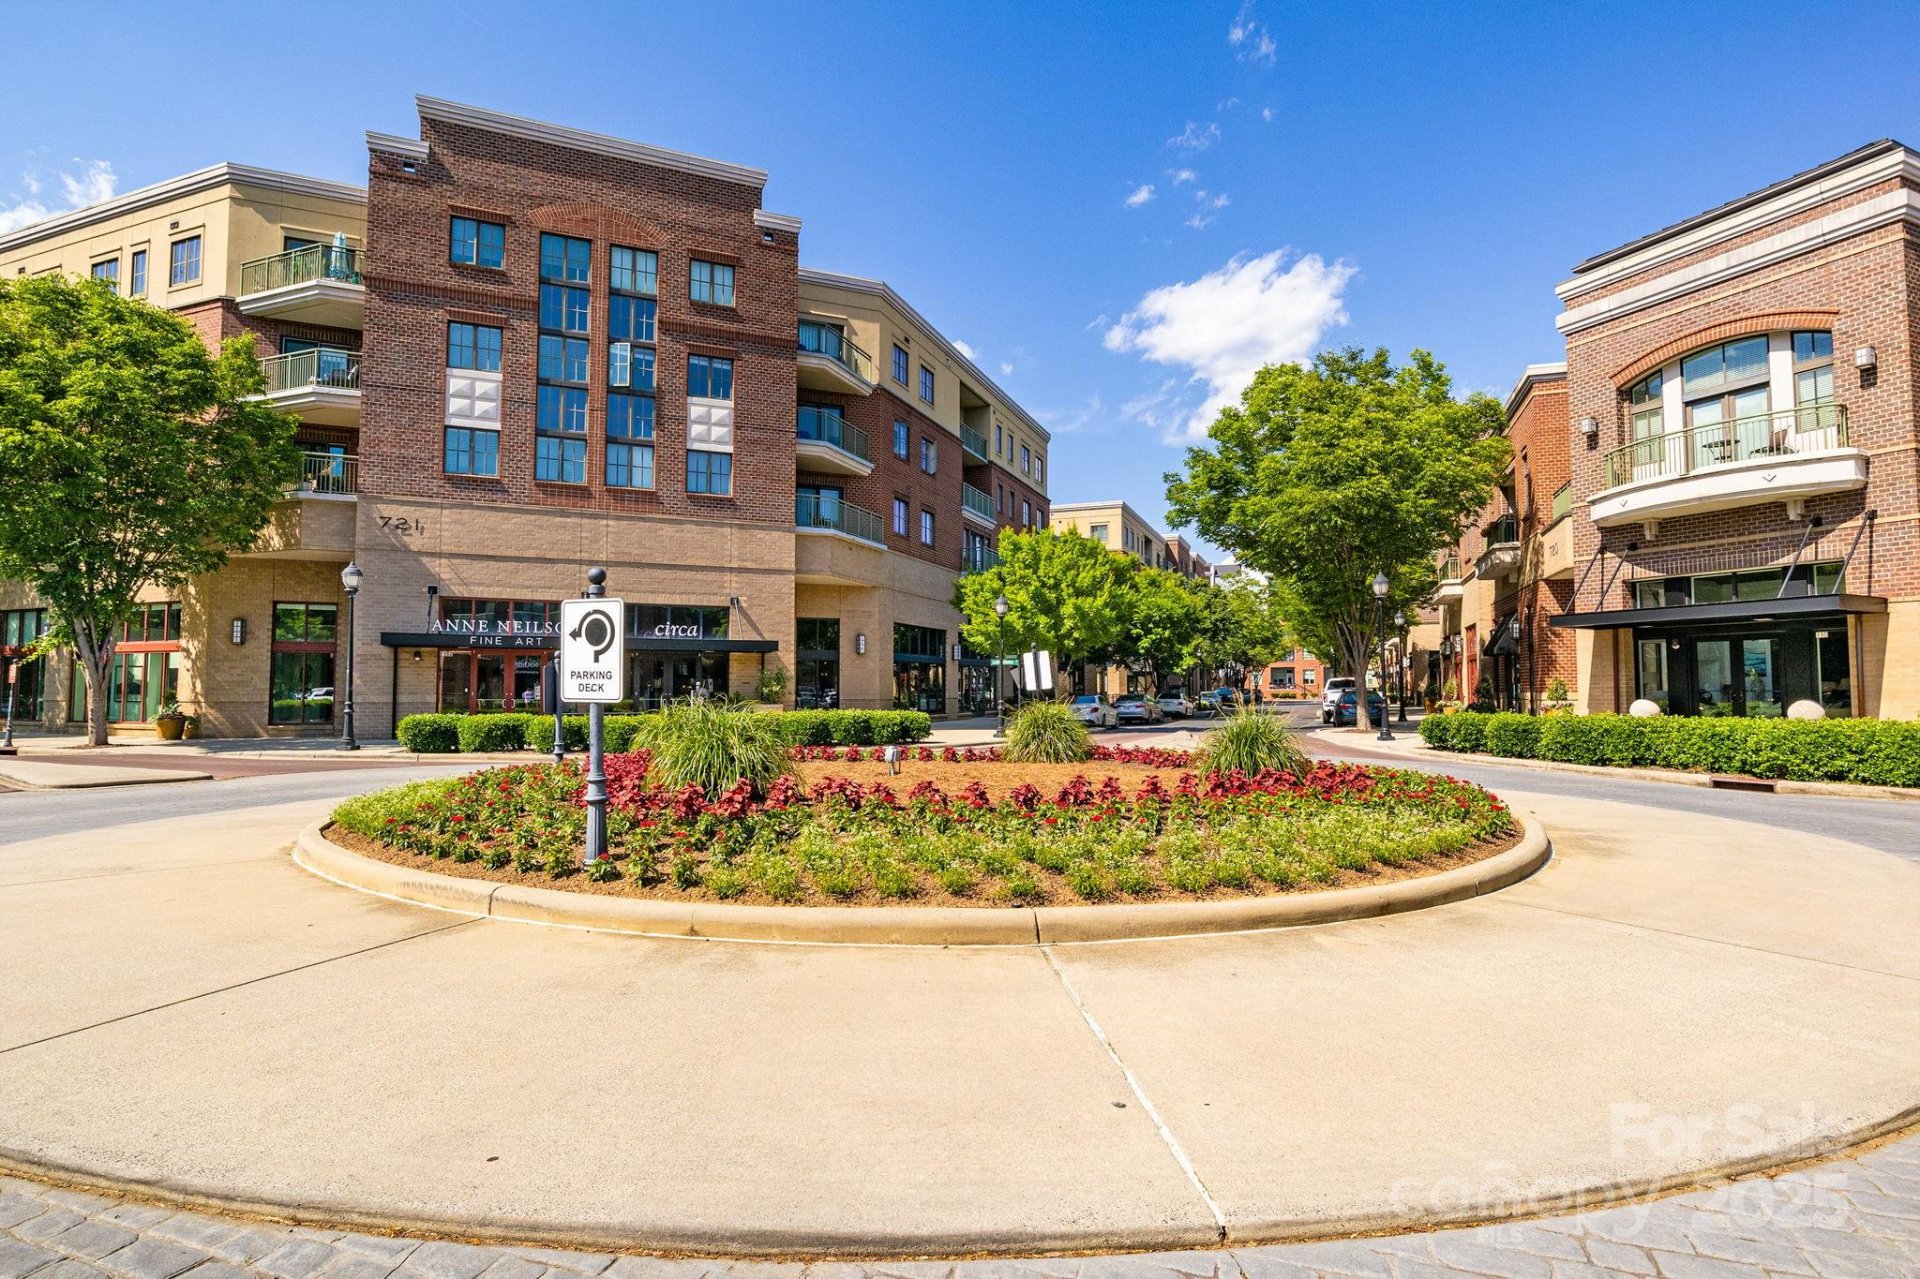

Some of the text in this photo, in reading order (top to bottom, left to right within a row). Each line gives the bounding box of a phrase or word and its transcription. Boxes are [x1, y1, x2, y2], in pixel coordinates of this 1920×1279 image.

[379, 516, 419, 531] 721
[431, 619, 489, 633] ANNE
[655, 621, 698, 637] circa
[470, 636, 543, 647] FINE ART
[570, 670, 613, 680] PARKING
[578, 683, 605, 692] DECK
